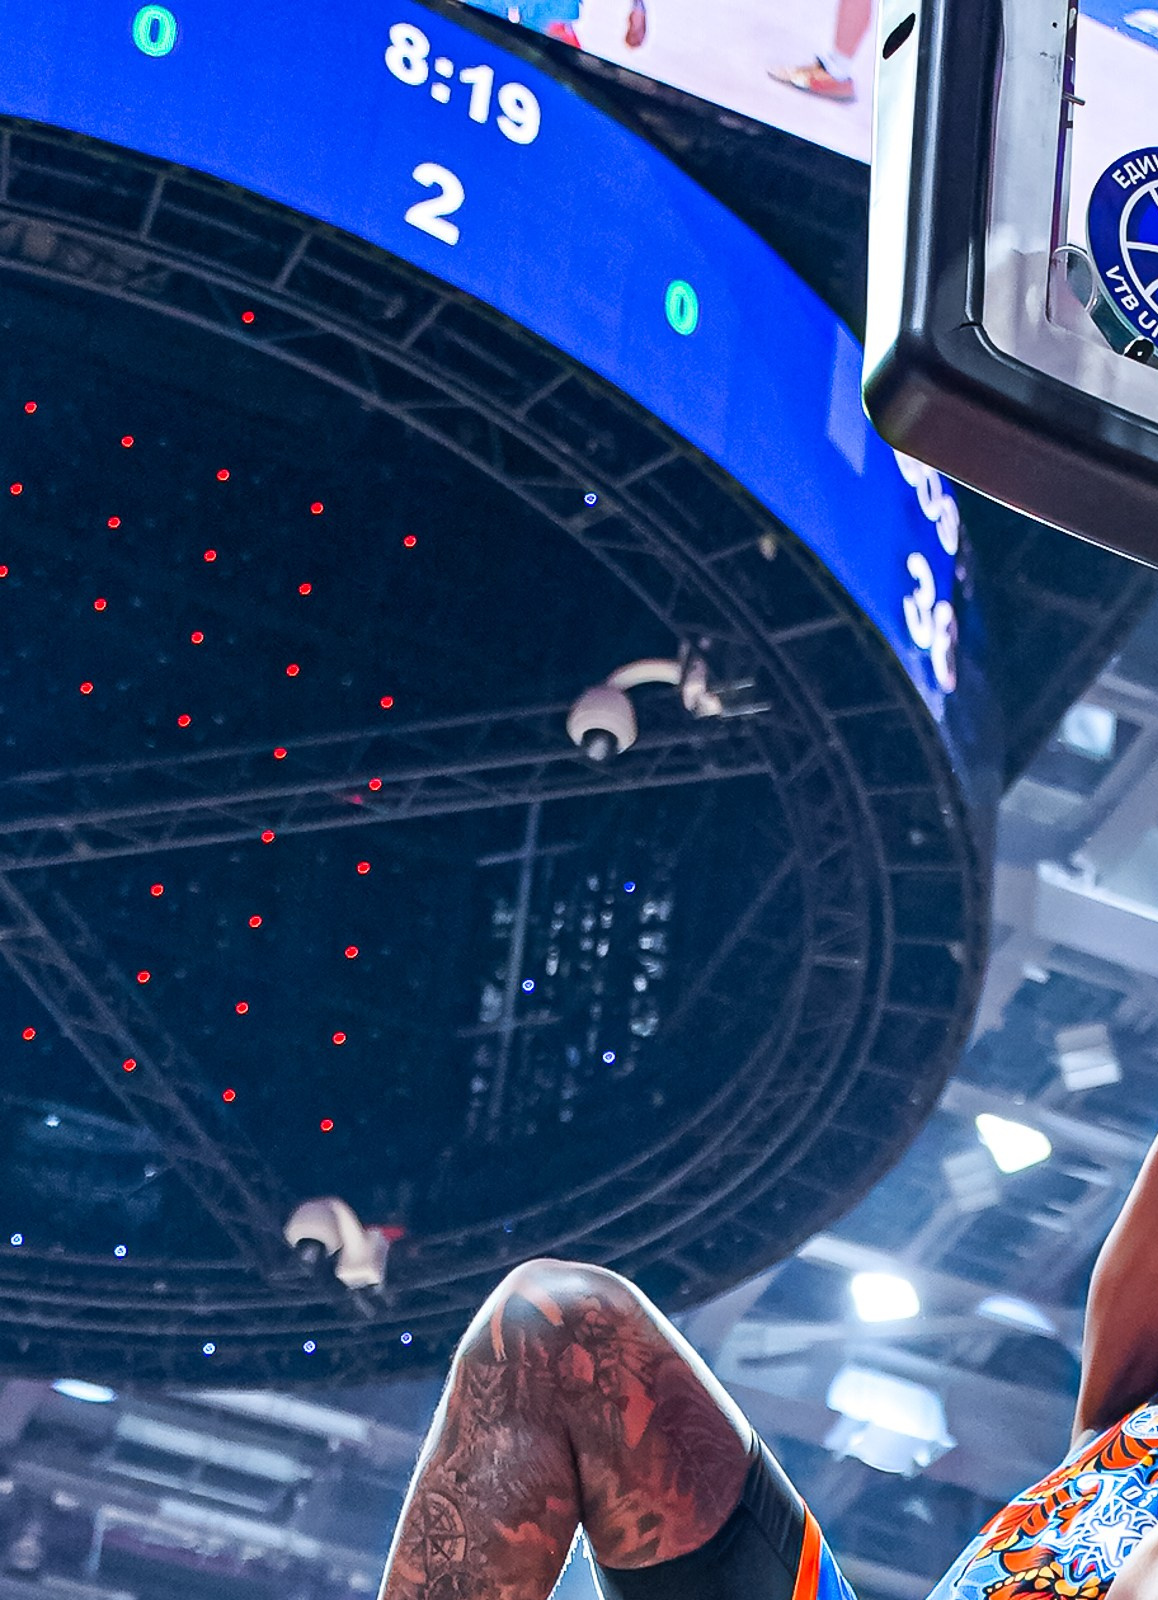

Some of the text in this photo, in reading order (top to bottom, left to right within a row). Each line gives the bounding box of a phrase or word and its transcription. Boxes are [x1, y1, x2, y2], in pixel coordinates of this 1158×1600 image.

[134, 5, 177, 57] 0
[385, 23, 541, 145] 8:19
[404, 163, 466, 246] 2
[664, 280, 699, 336] 0
[1106, 265, 1140, 314] VTB
